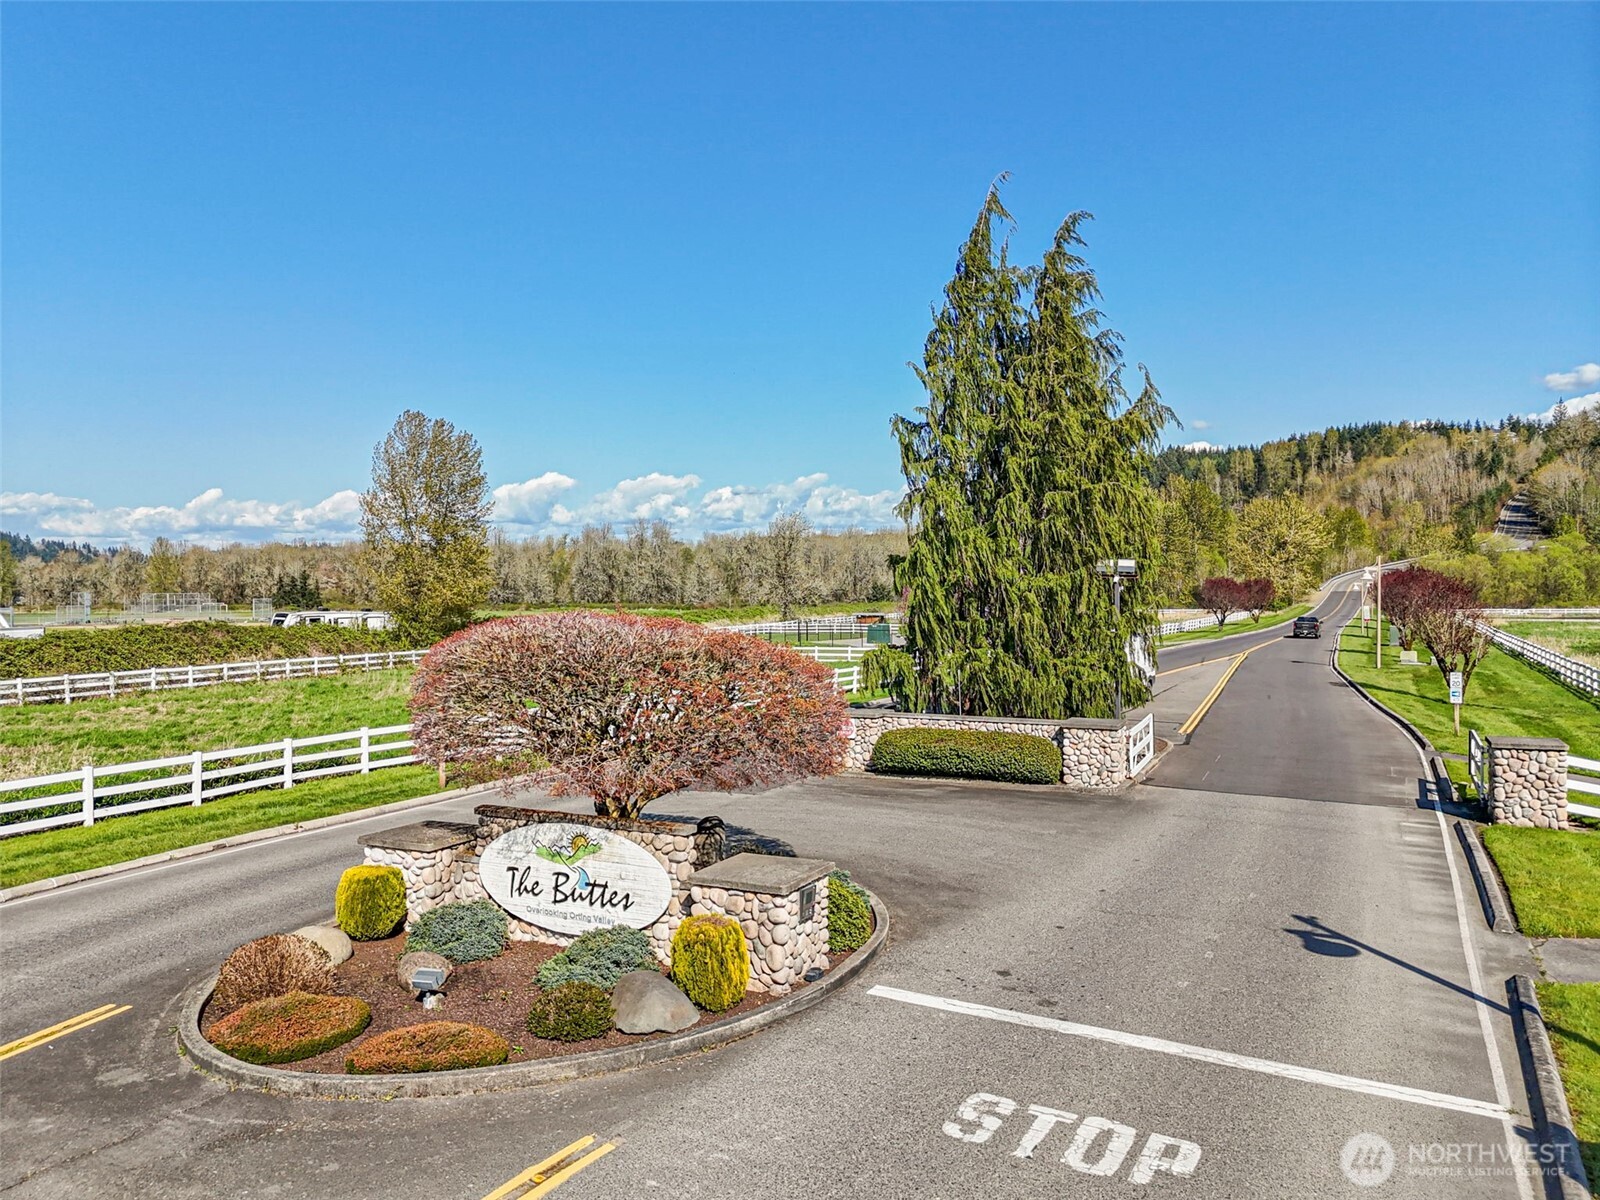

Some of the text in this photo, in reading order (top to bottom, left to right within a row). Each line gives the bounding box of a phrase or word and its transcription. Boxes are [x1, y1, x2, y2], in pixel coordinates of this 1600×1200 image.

[506, 866, 635, 911] The Buttes
[526, 905, 616, 926] Overlooking Orting Valley
[942, 1093, 1202, 1185] STOP
